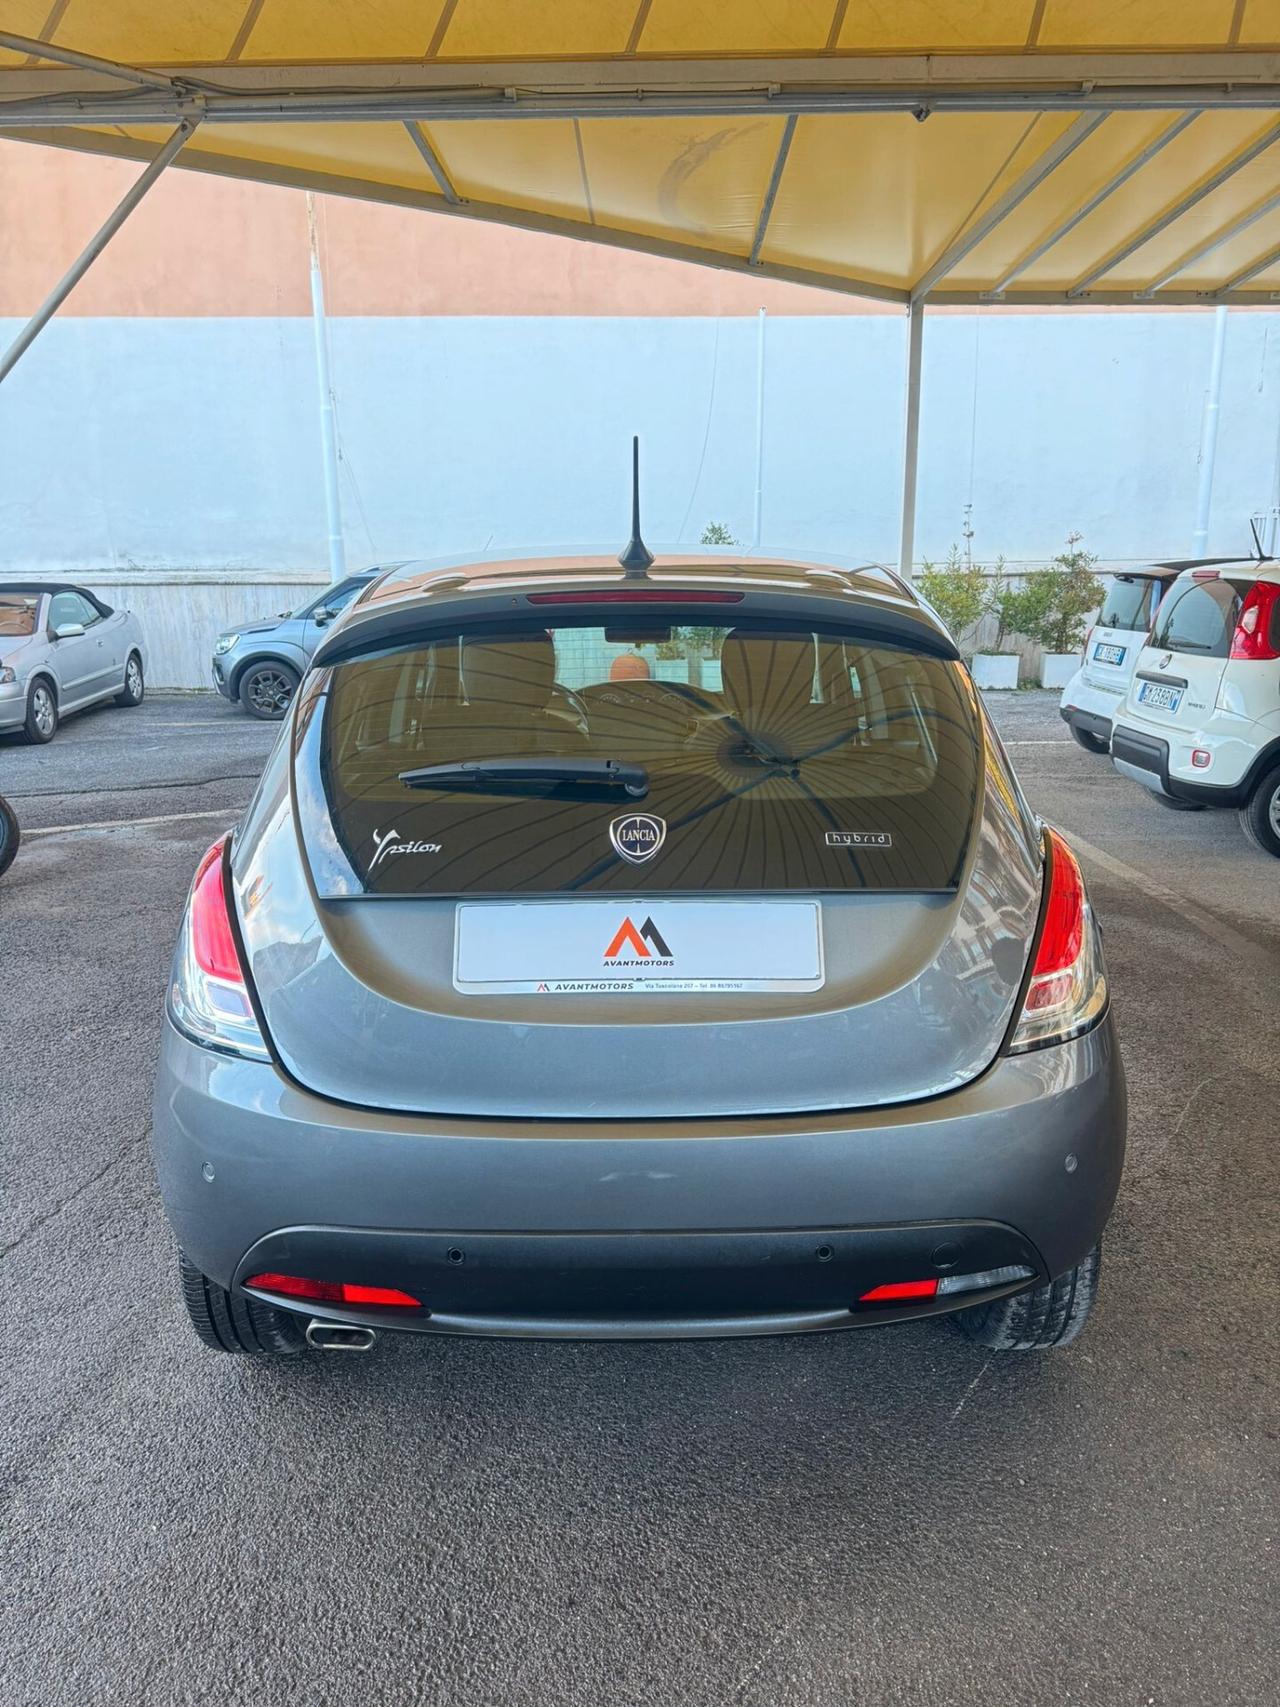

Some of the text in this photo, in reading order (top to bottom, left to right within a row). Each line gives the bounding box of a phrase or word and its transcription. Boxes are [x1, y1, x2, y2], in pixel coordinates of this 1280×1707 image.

[622, 829, 655, 841] LANCIA
[833, 832, 885, 845] hybrid
[368, 828, 442, 871] Ypsilon
[555, 983, 634, 991] AVANTMOTORS
